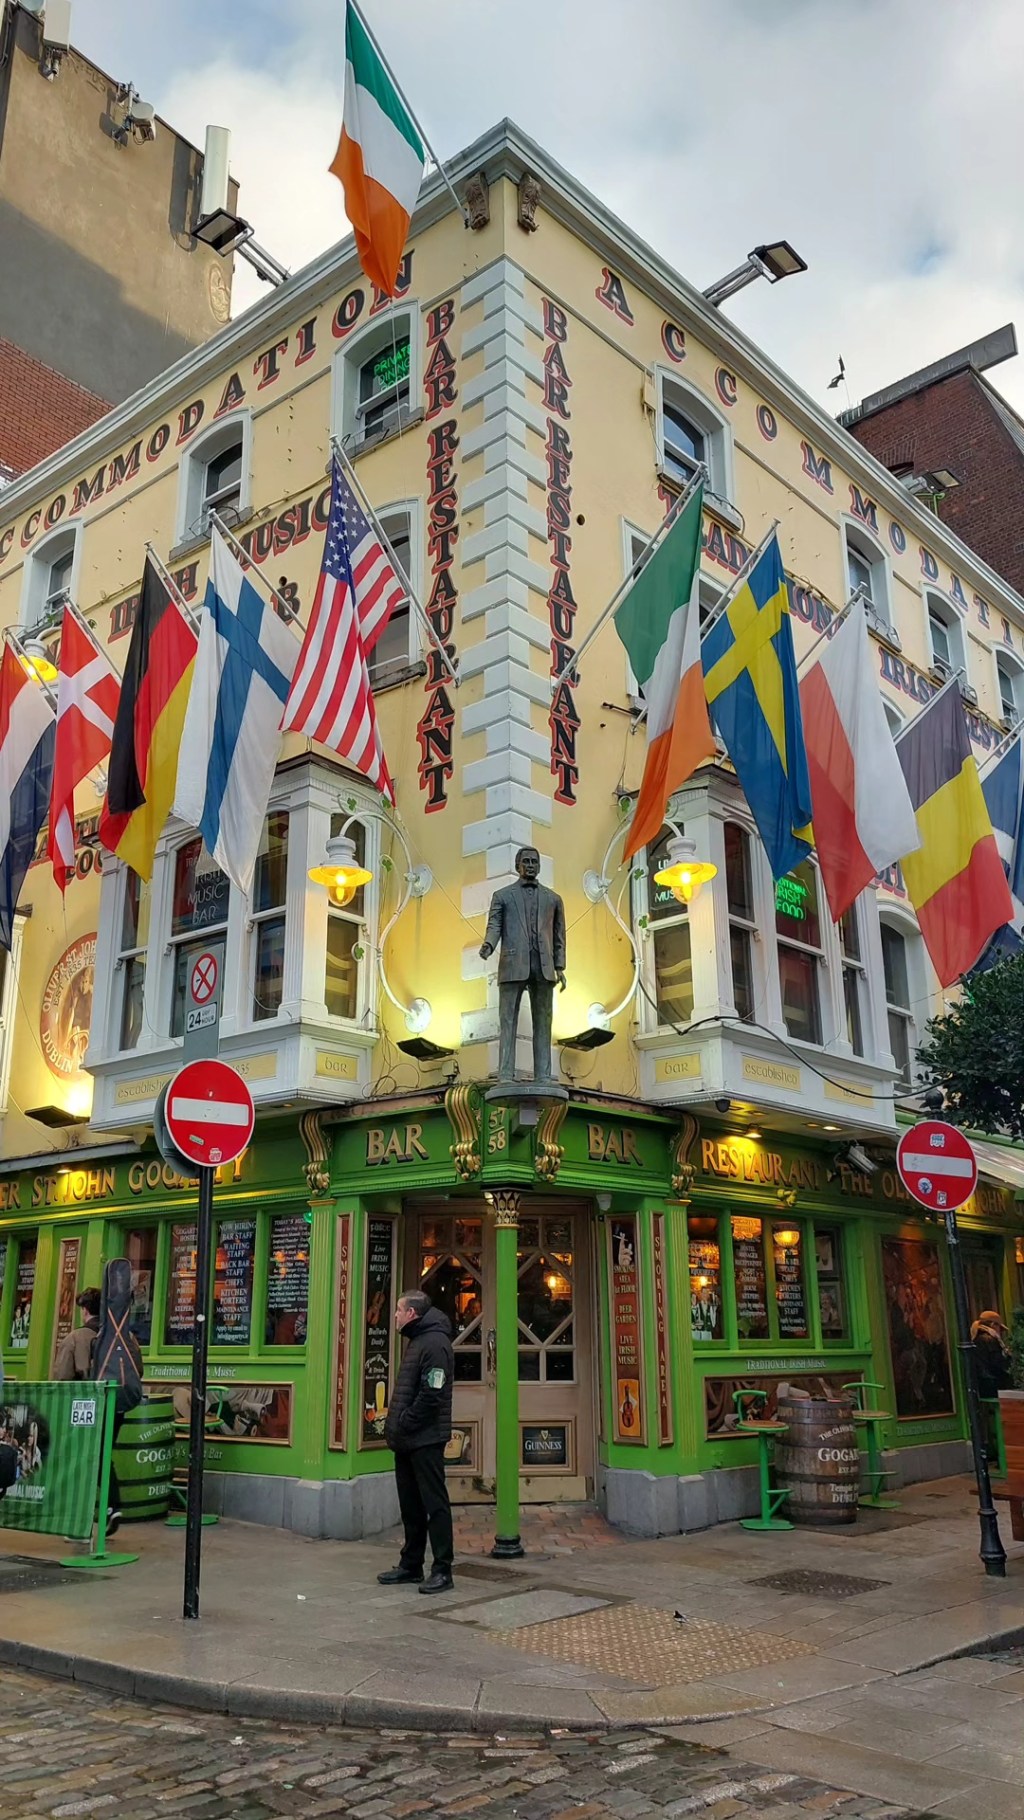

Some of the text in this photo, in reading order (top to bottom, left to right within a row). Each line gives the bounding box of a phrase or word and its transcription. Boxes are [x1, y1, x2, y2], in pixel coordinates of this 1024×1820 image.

[416, 299, 461, 814] BAR RESTAURANT
[541, 296, 582, 807] BAR RESTAURANT
[187, 882, 224, 906] MUSIC
[655, 889, 676, 903] MUS
[192, 905, 217, 925] BAR
[776, 899, 804, 920] FOOD
[43, 962, 67, 1012] OLIVER
[188, 1011, 202, 1029] 24
[42, 1029, 73, 1073] DUBLIN
[488, 1107, 506, 1129] 57
[366, 1123, 429, 1167] BAR
[488, 1130, 506, 1153] 58
[587, 1123, 642, 1165] BAR
[701, 1137, 821, 1191] RESTAURANT
[63, 1166, 116, 1204] JOHN
[220, 1221, 257, 1232] NOW HIRING
[222, 1231, 254, 1241] BAR STAFF
[224, 1242, 250, 1251] WAITING
[226, 1249, 245, 1258] STAFF
[371, 1254, 388, 1263] IRISH
[225, 1268, 244, 1277] STAFF
[369, 1263, 389, 1273] MUSIC
[220, 1288, 248, 1297] KITCHEN
[338, 1246, 348, 1345] SMOKING
[220, 1296, 247, 1305] PORTERS
[223, 1312, 242, 1321] STAFF
[615, 1315, 637, 1324] GARDEN
[654, 1236, 667, 1408] SMOKING AREA
[620, 1335, 634, 1344] LIVE
[619, 1345, 636, 1355] IRISH
[618, 1355, 638, 1365] MUSIC
[150, 1366, 191, 1377] Traditional
[211, 1365, 237, 1377] Music
[72, 1411, 93, 1424] BAR
[525, 1440, 562, 1450] GUINNESS
